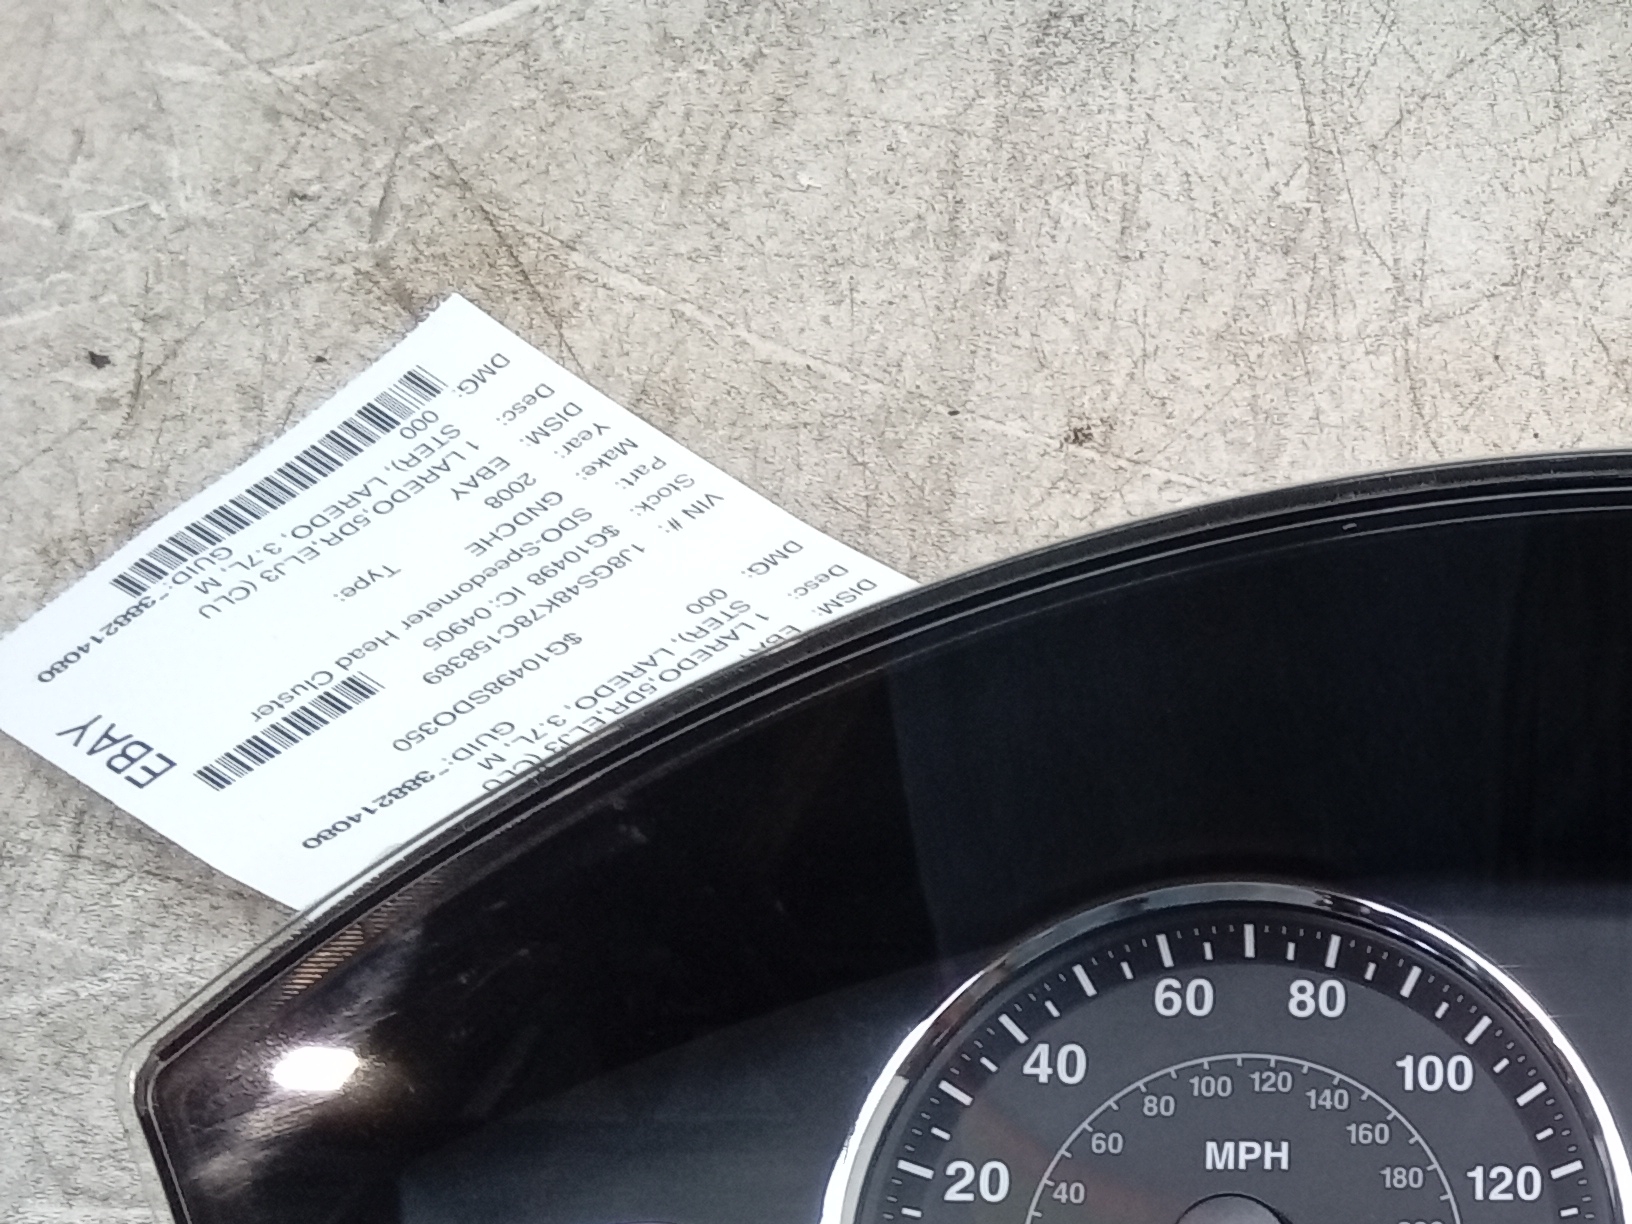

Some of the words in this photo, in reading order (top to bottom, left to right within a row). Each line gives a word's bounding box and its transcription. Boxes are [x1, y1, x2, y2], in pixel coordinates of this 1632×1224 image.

[442, 352, 511, 398] DMG:
[496, 383, 556, 426] Desc:
[519, 401, 583, 445] DISM:
[391, 410, 439, 440] 000
[554, 422, 611, 455] Year:
[384, 424, 461, 472] STER),
[576, 437, 639, 476] Make:
[450, 456, 511, 501] EBAY
[615, 455, 667, 487] Part:
[281, 476, 388, 540] LAREDO,
[484, 472, 537, 509] 2008
[629, 473, 695, 516] Stock:
[681, 493, 725, 520] VIN
[464, 491, 563, 557] GNDCHE
[220, 542, 282, 572] 3.7L,
[401, 507, 593, 631] SDO-Speedometer
[526, 524, 620, 586] $G10498
[741, 540, 804, 576] DMG:
[193, 576, 223, 595] M
[333, 564, 402, 602] Type:
[488, 586, 527, 608] IC:
[787, 564, 849, 597] Desc:
[811, 578, 878, 617] DISM:
[198, 580, 258, 620] (CLU
[686, 588, 728, 615] 000
[422, 607, 492, 651] 04905
[671, 600, 751, 643] STER),
[334, 630, 400, 671] Head
[250, 670, 334, 723] Cluster
[564, 647, 675, 710] LAREDO,
[503, 714, 567, 747] 3.7L,
[55, 714, 178, 790] EBAY
[476, 752, 507, 771] M
[1154, 978, 1214, 1017] 60
[1288, 979, 1346, 1018] 80
[1023, 1044, 1086, 1084] 40
[1249, 1071, 1293, 1093] 120
[1395, 1054, 1474, 1092] 100
[1189, 1075, 1232, 1097] 100
[1305, 1088, 1349, 1110] 140
[1142, 1095, 1175, 1117] 80
[1091, 1132, 1124, 1154] 60
[1345, 1122, 1390, 1145] 160
[1205, 1141, 1289, 1170] MPH
[943, 1160, 1010, 1203] 20
[1052, 1182, 1085, 1204] 40
[1380, 1166, 1424, 1189] 180
[1466, 1165, 1542, 1201] 120
